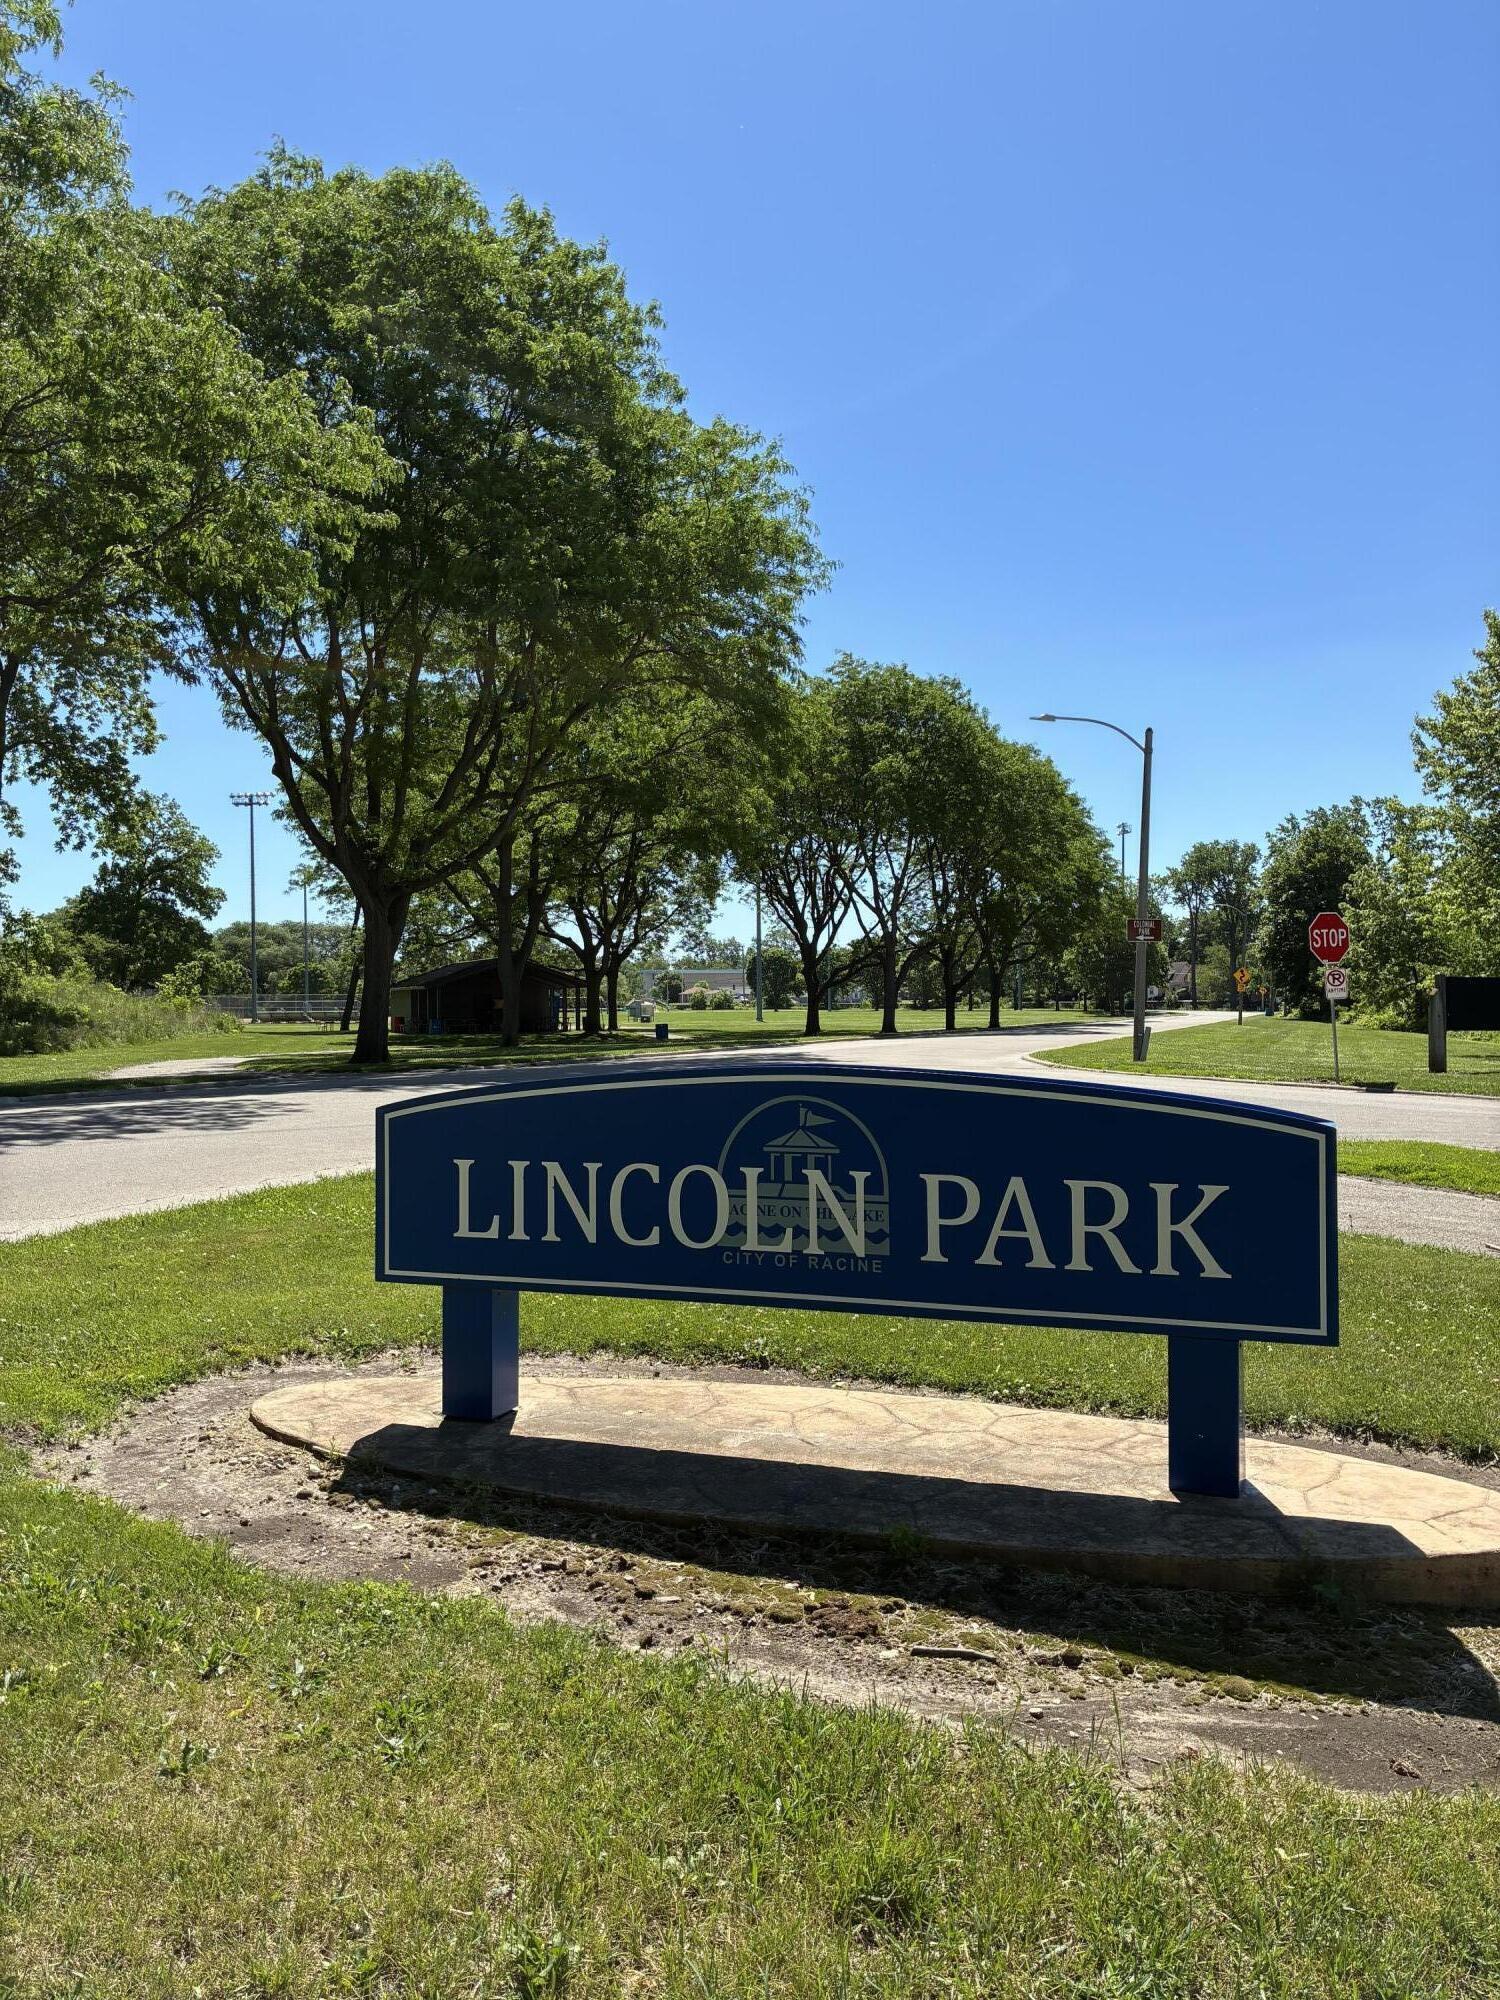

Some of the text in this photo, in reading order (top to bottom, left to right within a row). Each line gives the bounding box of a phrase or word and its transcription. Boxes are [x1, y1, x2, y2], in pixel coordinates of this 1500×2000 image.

[1138, 928, 1150, 936] PARK
[1312, 928, 1347, 948] STOP
[452, 1158, 1232, 1279] LINCOLN PARK
[729, 1203, 885, 1222] ACNE ON HE KE
[722, 1251, 883, 1273] CITY OF RACINE
